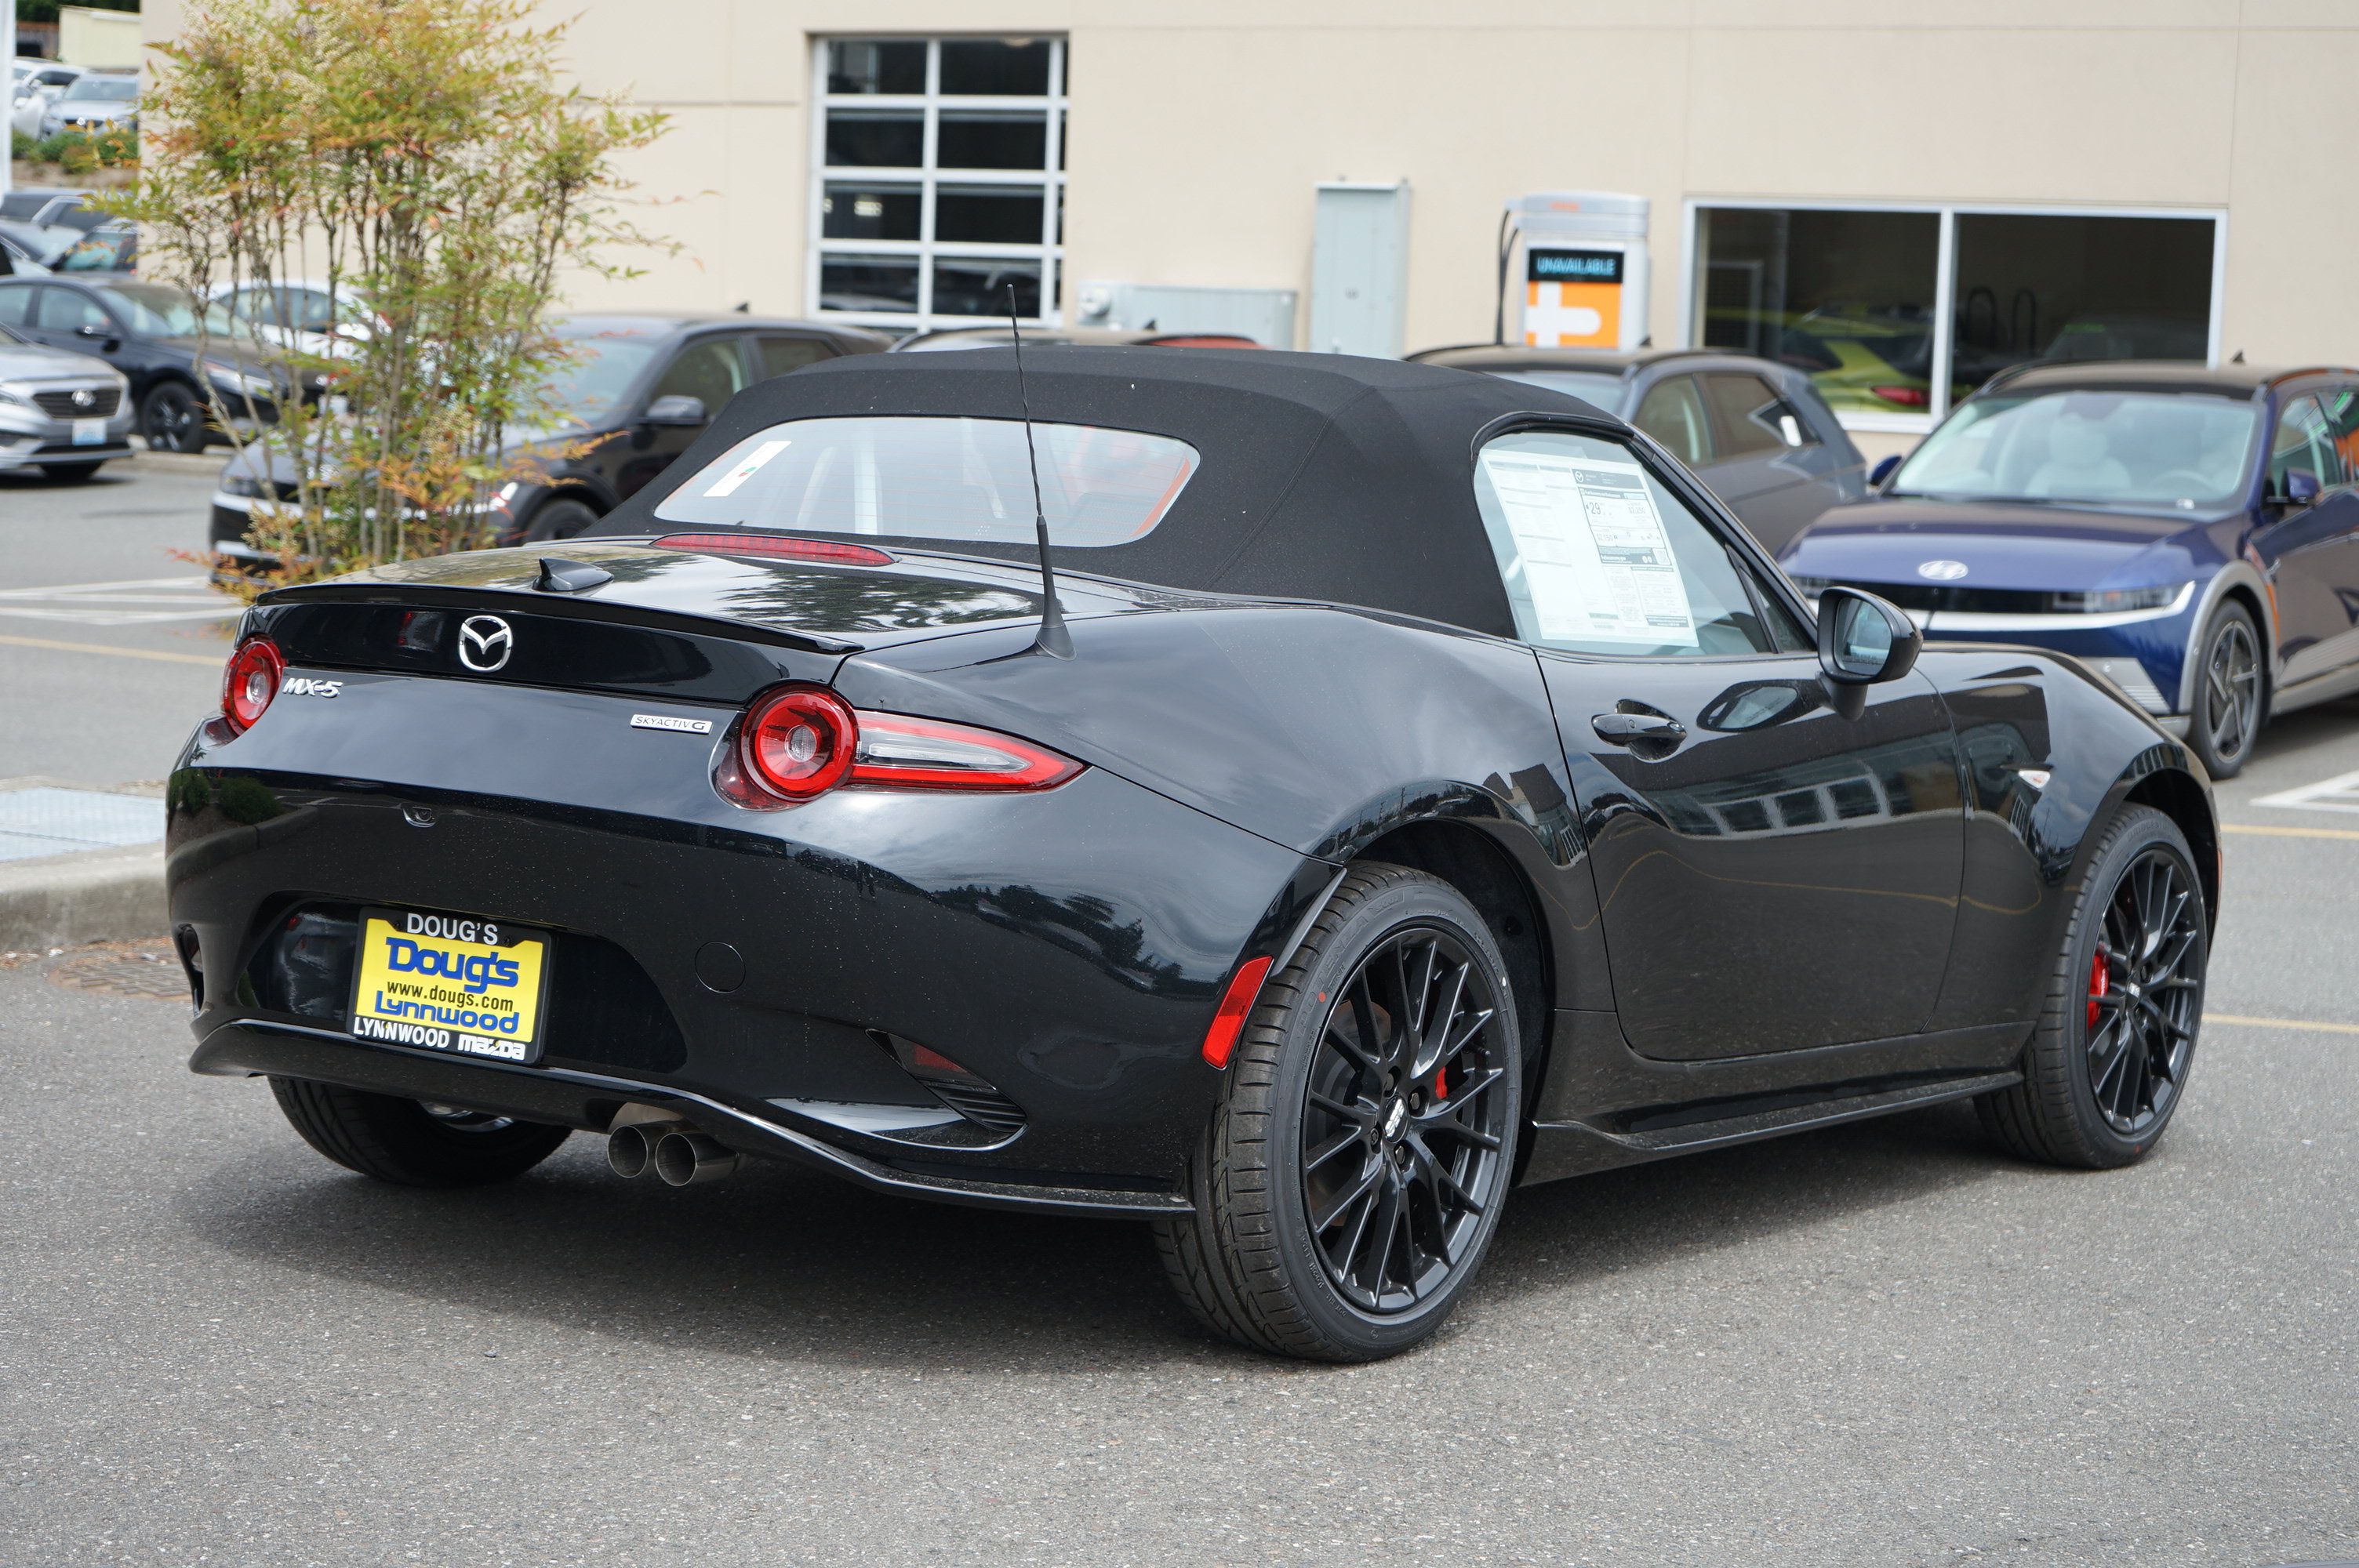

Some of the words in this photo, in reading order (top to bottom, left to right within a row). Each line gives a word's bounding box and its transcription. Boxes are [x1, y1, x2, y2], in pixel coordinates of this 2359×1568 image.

[1536, 256, 1616, 276] UNAVAILABLE
[282, 677, 343, 699] MX-5
[406, 913, 499, 946] DOUG'S
[387, 981, 514, 1012] www.dougs.com
[374, 990, 520, 1035] Lynnwood
[353, 1017, 450, 1048] LYNNWOOD
